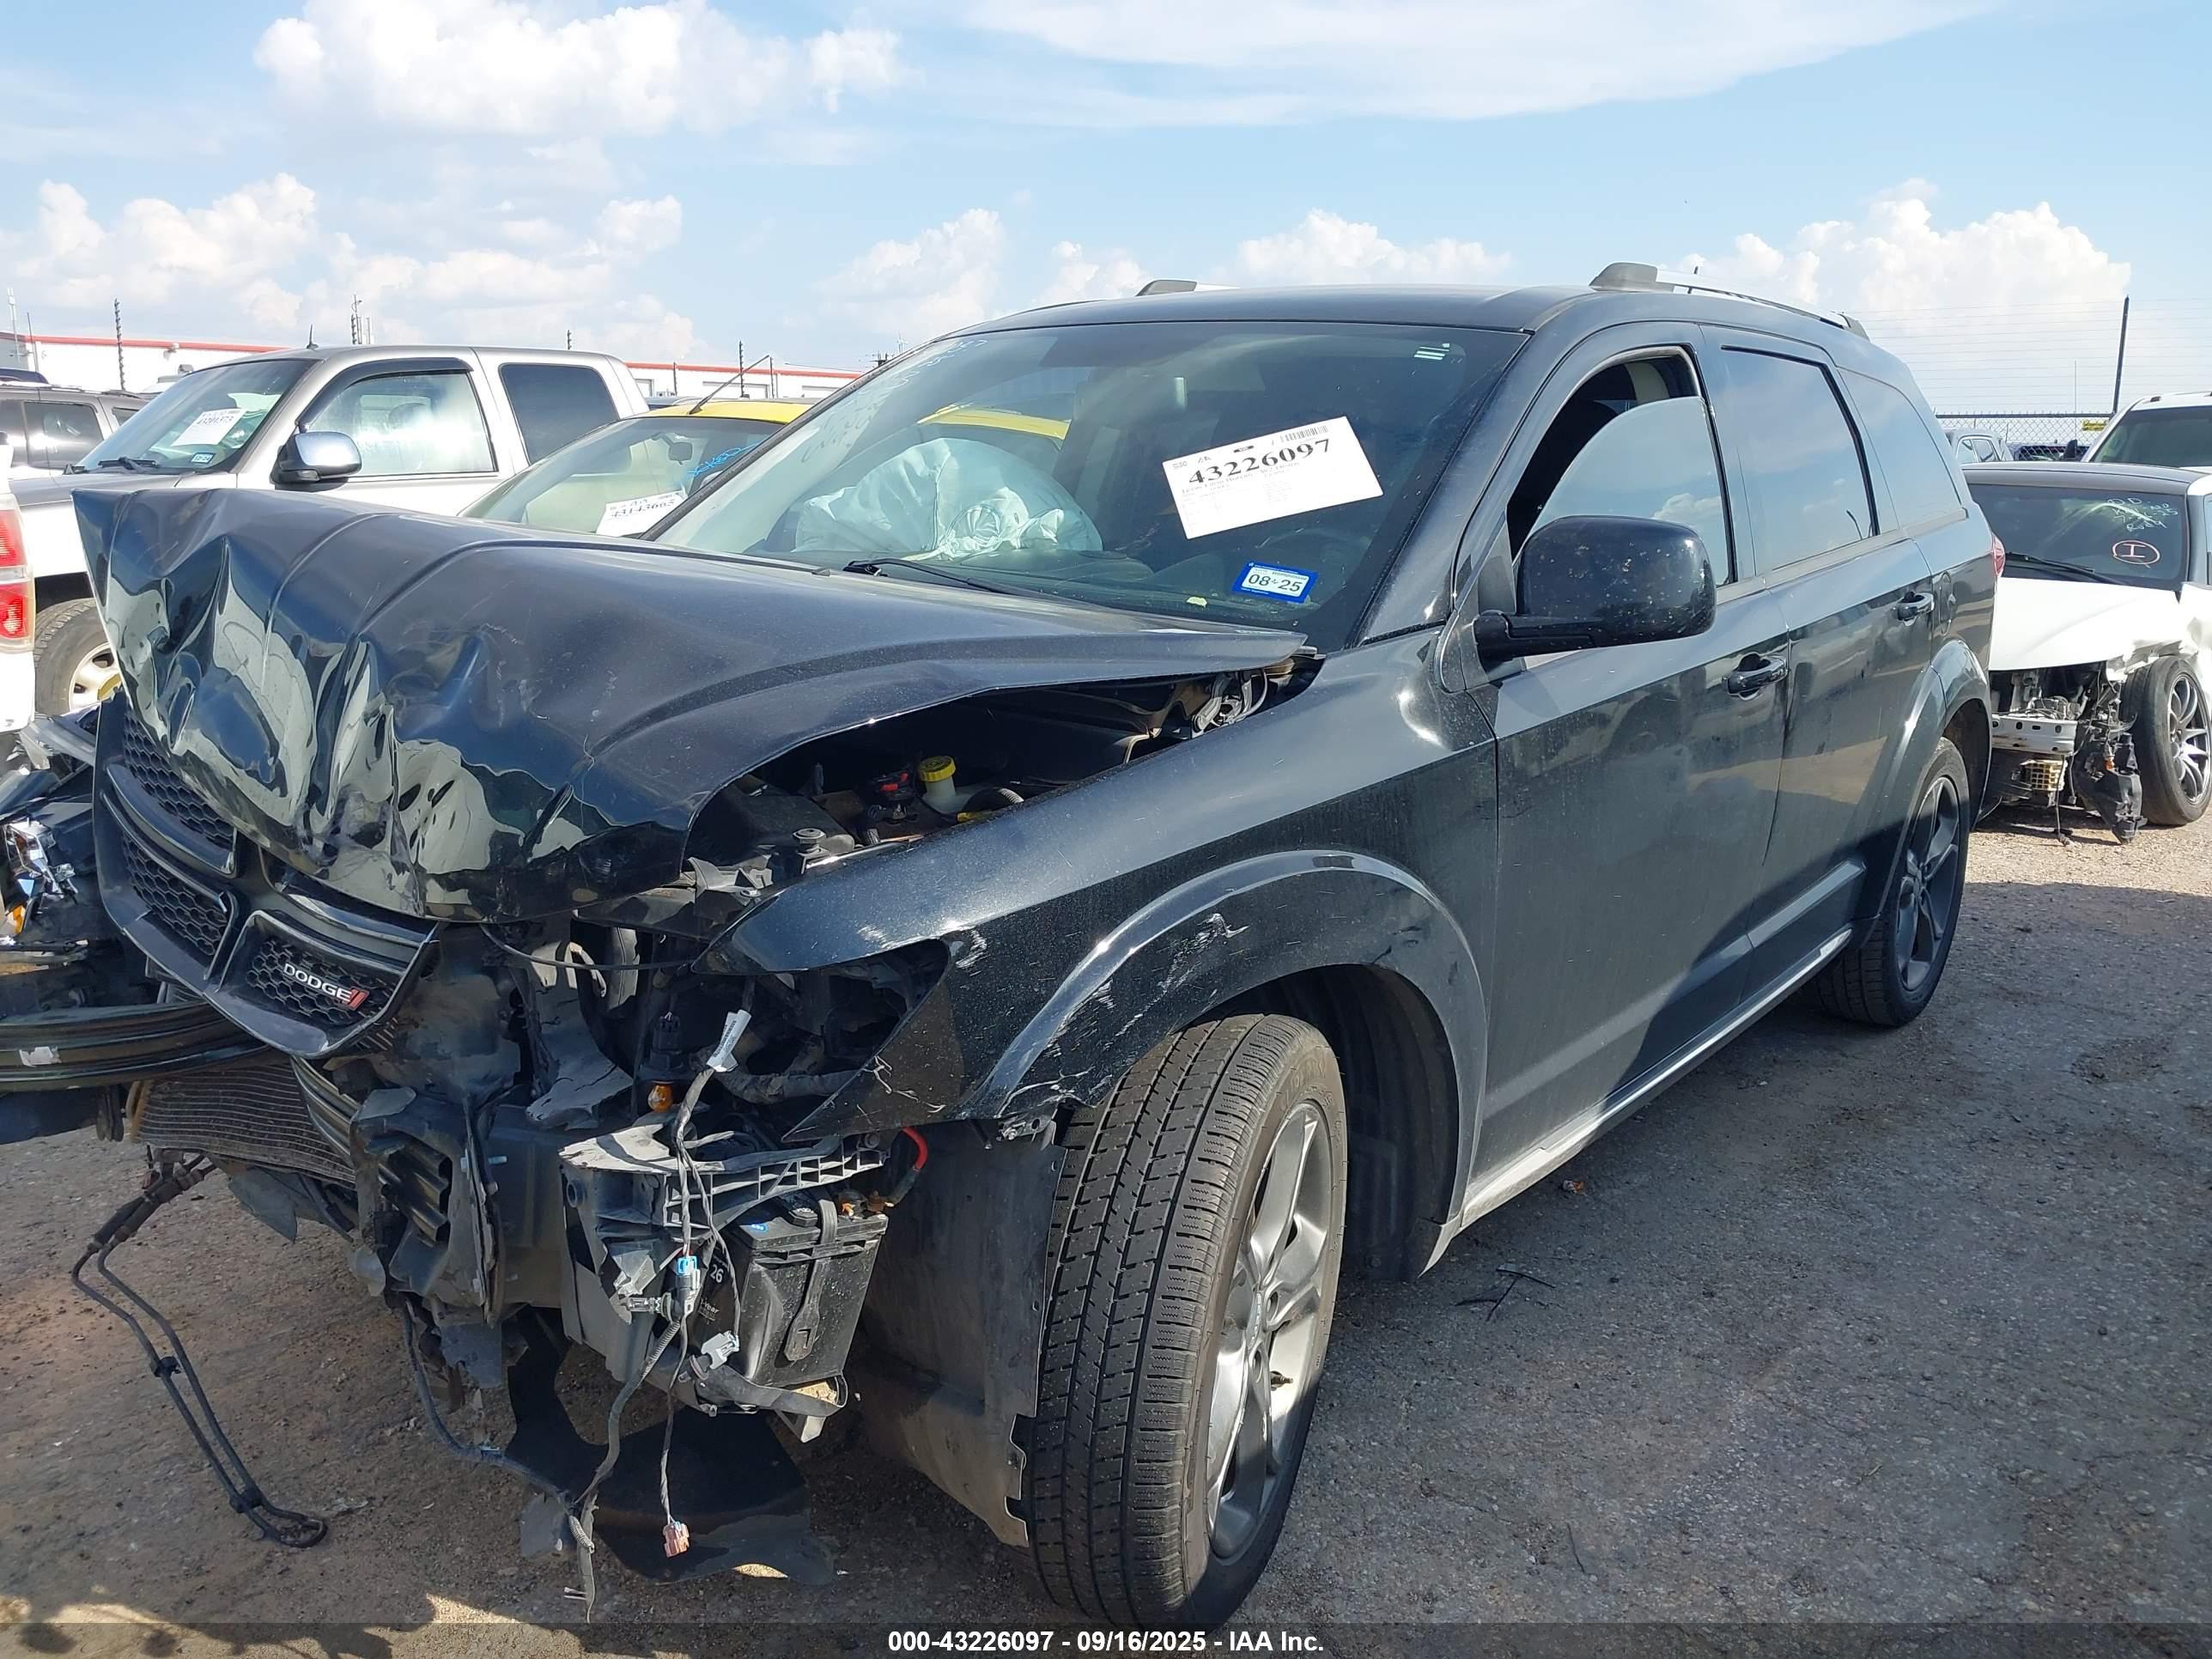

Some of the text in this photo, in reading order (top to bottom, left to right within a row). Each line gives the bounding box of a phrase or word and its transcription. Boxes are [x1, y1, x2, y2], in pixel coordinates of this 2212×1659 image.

[1188, 438, 1330, 484] 43226097
[1248, 574, 1271, 586] 08
[1278, 579, 1303, 592] 25
[283, 963, 353, 1003] DODGE
[709, 1264, 724, 1284] 26
